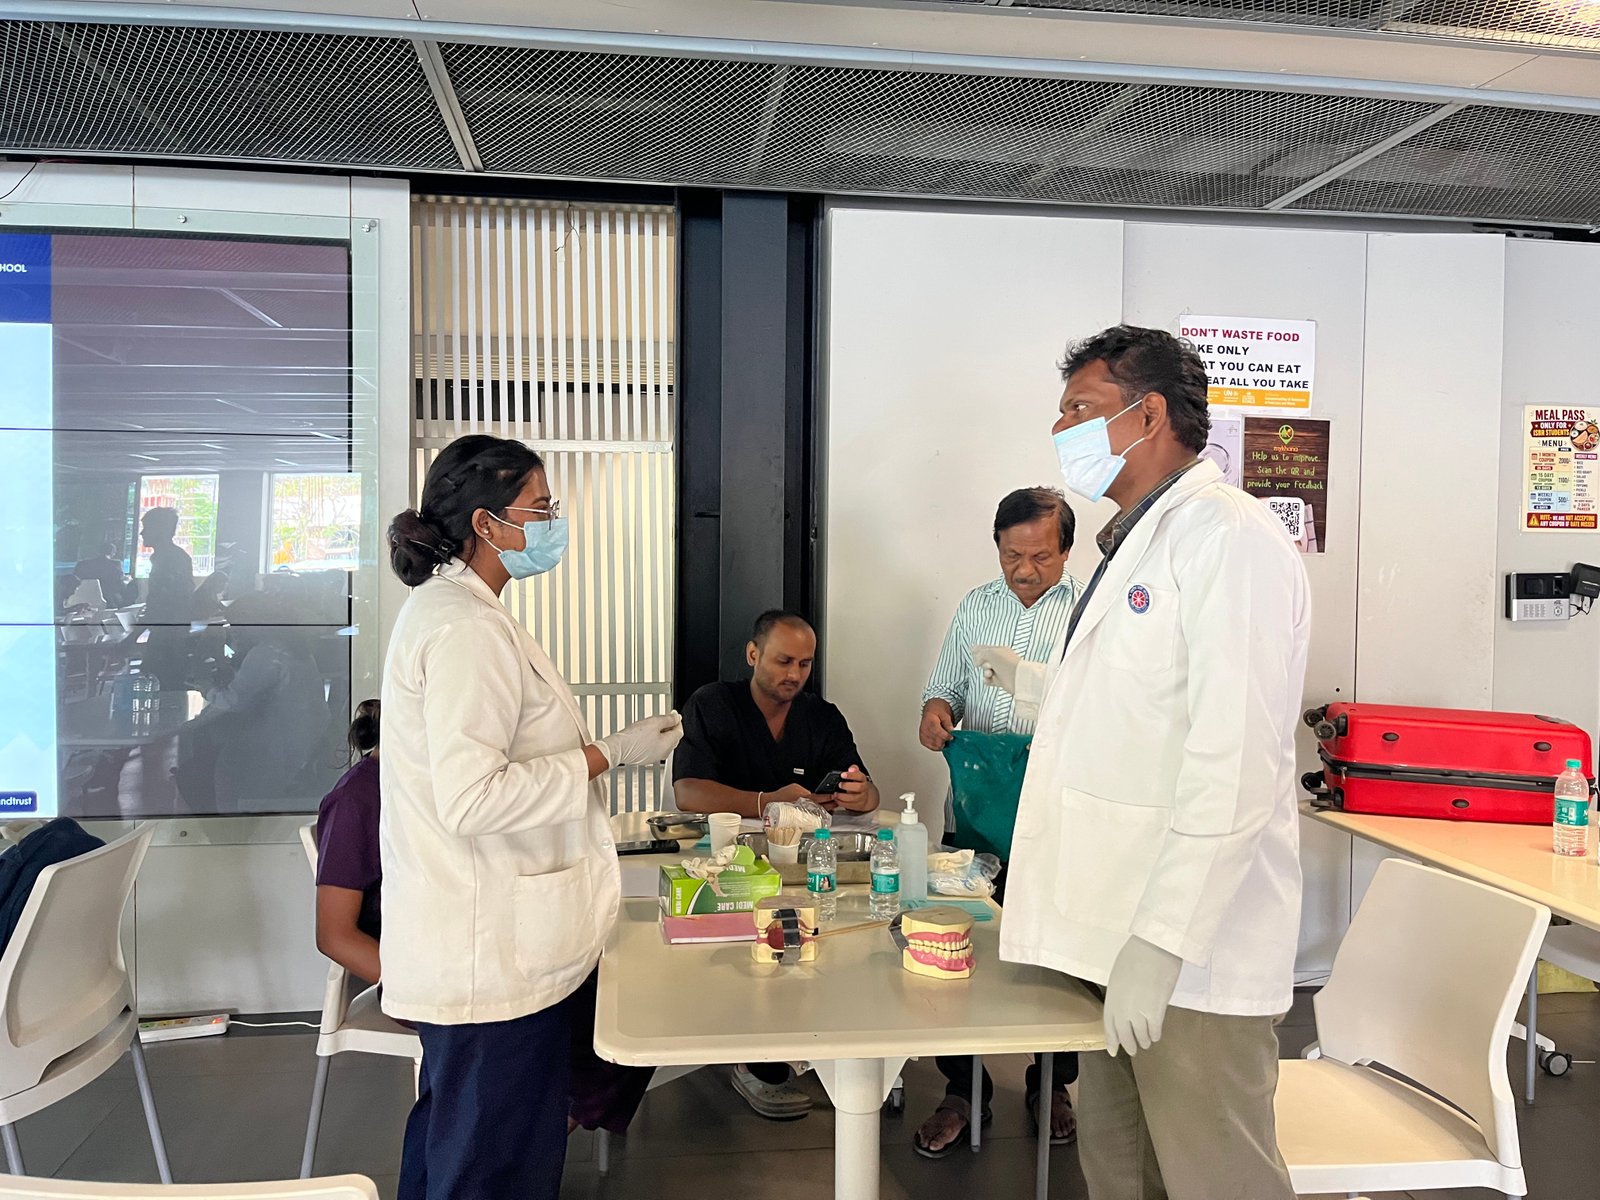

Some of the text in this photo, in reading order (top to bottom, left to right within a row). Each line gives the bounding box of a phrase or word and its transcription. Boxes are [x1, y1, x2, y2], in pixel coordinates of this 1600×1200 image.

[1181, 327, 1300, 342] DON'T WASTE FOOD
[1197, 344, 1249, 355] KE ONLY
[1202, 360, 1301, 374] AT YOU CAN EAT
[1229, 377, 1249, 387] ALL
[1253, 378, 1276, 388] YOU
[1279, 379, 1309, 389] TAKE
[1536, 410, 1584, 420] MEAL PASS
[1252, 451, 1268, 461] Help
[1282, 453, 1289, 461] to
[1257, 465, 1315, 476] Scan the QR and
[1247, 478, 1271, 488] provide
[1275, 481, 1290, 489] your
[0, 796, 32, 805] ndtrust
[717, 901, 753, 911] MEDI CARE
